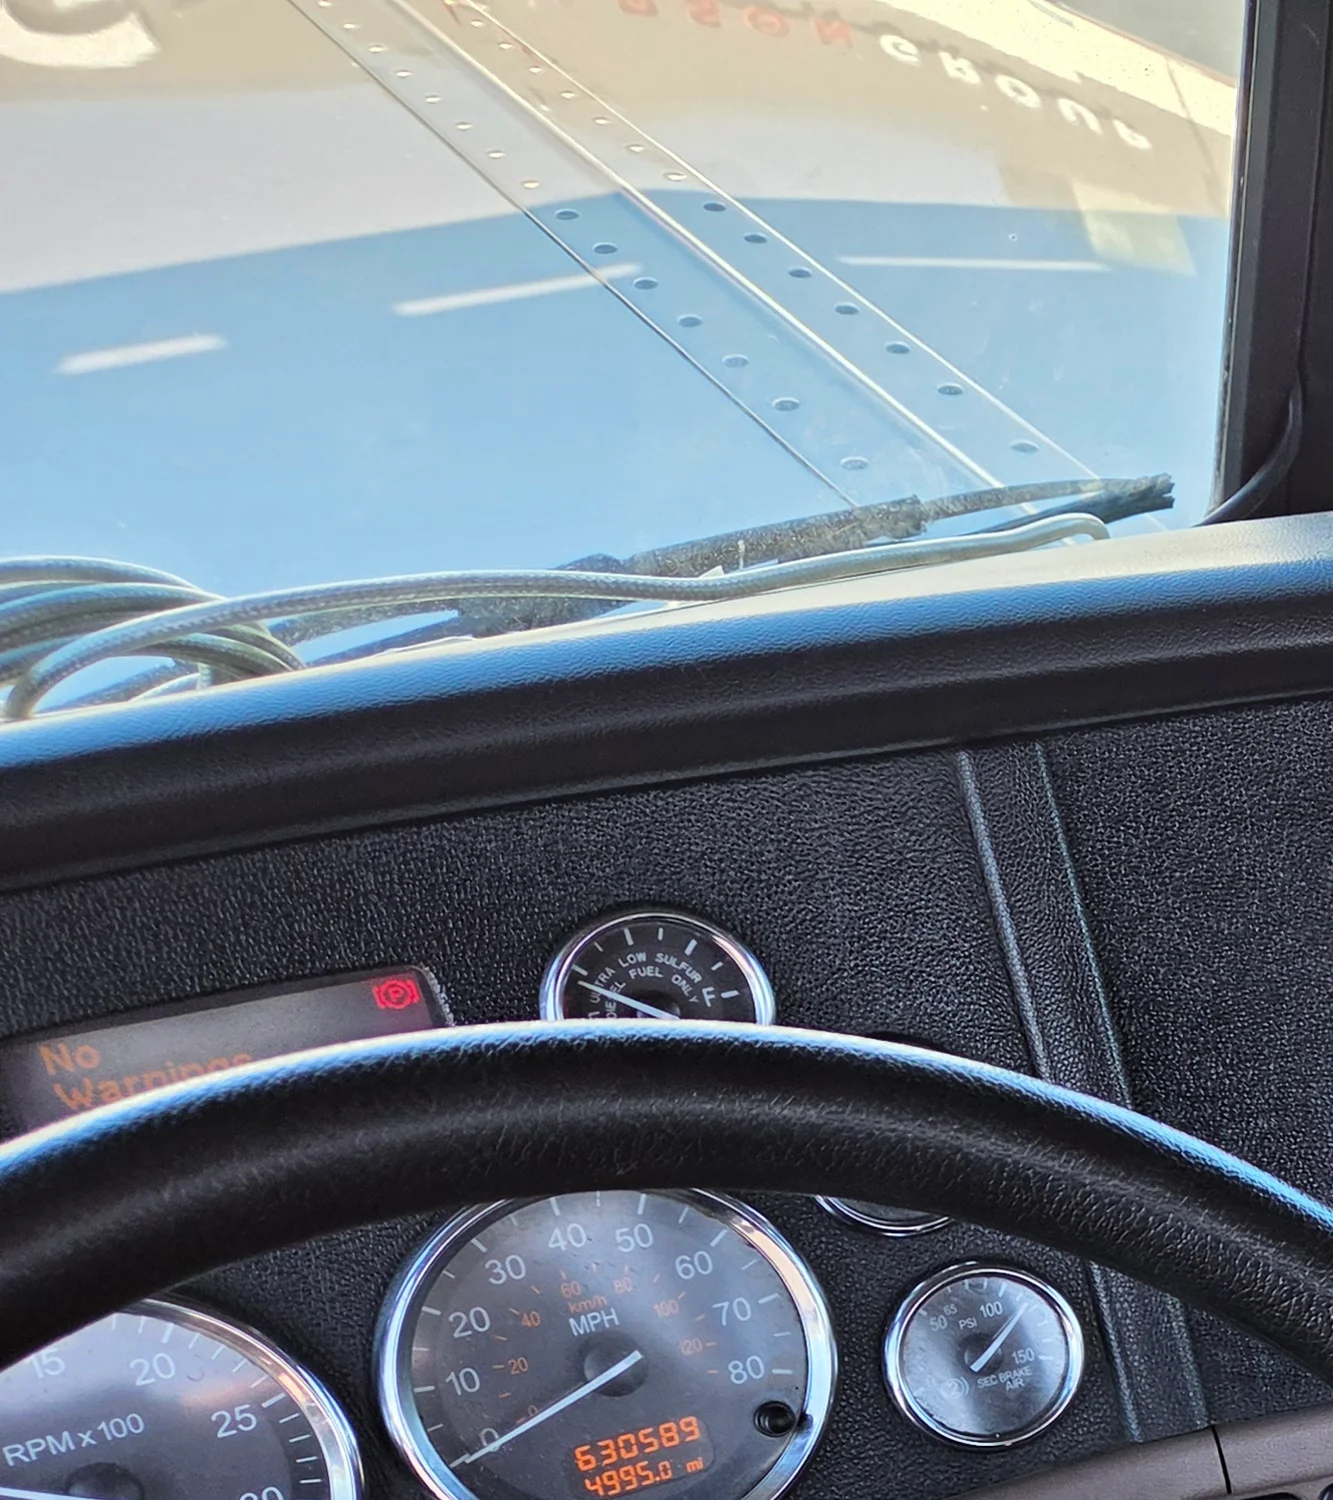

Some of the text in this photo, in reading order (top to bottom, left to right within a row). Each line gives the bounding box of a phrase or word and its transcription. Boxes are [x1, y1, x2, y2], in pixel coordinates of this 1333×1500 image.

[590, 951, 702, 1004] UTRA LOW SULFUR
[605, 966, 699, 1018] DIEEL FUEL ONLY
[702, 986, 717, 1008] F
[37, 1041, 102, 1076] No
[548, 1223, 588, 1251] 40
[615, 1223, 654, 1253] 50
[484, 1254, 527, 1285] 30
[674, 1250, 713, 1280] 60
[560, 1280, 582, 1299] 60
[612, 1276, 634, 1295] 80
[568, 1295, 608, 1314] km/h
[654, 1299, 680, 1318] 100
[712, 1297, 752, 1326] 70
[980, 1301, 1003, 1318] 100
[448, 1306, 491, 1339] 20
[521, 1310, 541, 1328] 40
[568, 1307, 620, 1337] MPH
[930, 1315, 948, 1332] 50
[958, 1317, 978, 1330] PSI
[679, 1337, 703, 1356] 120
[1012, 1347, 1035, 1364] 150
[25, 1350, 66, 1378] 15
[129, 1352, 176, 1387] 20
[508, 1357, 529, 1375] 20
[727, 1355, 765, 1385] 80
[977, 1365, 1033, 1389] SEC BRAKE
[445, 1367, 481, 1396] 10
[1005, 1378, 1025, 1391] AIR
[210, 1404, 258, 1438] 25
[2, 1413, 145, 1467] RPM x 100
[574, 1415, 701, 1472] 630589
[584, 1457, 704, 1497] 4995.0 mi
